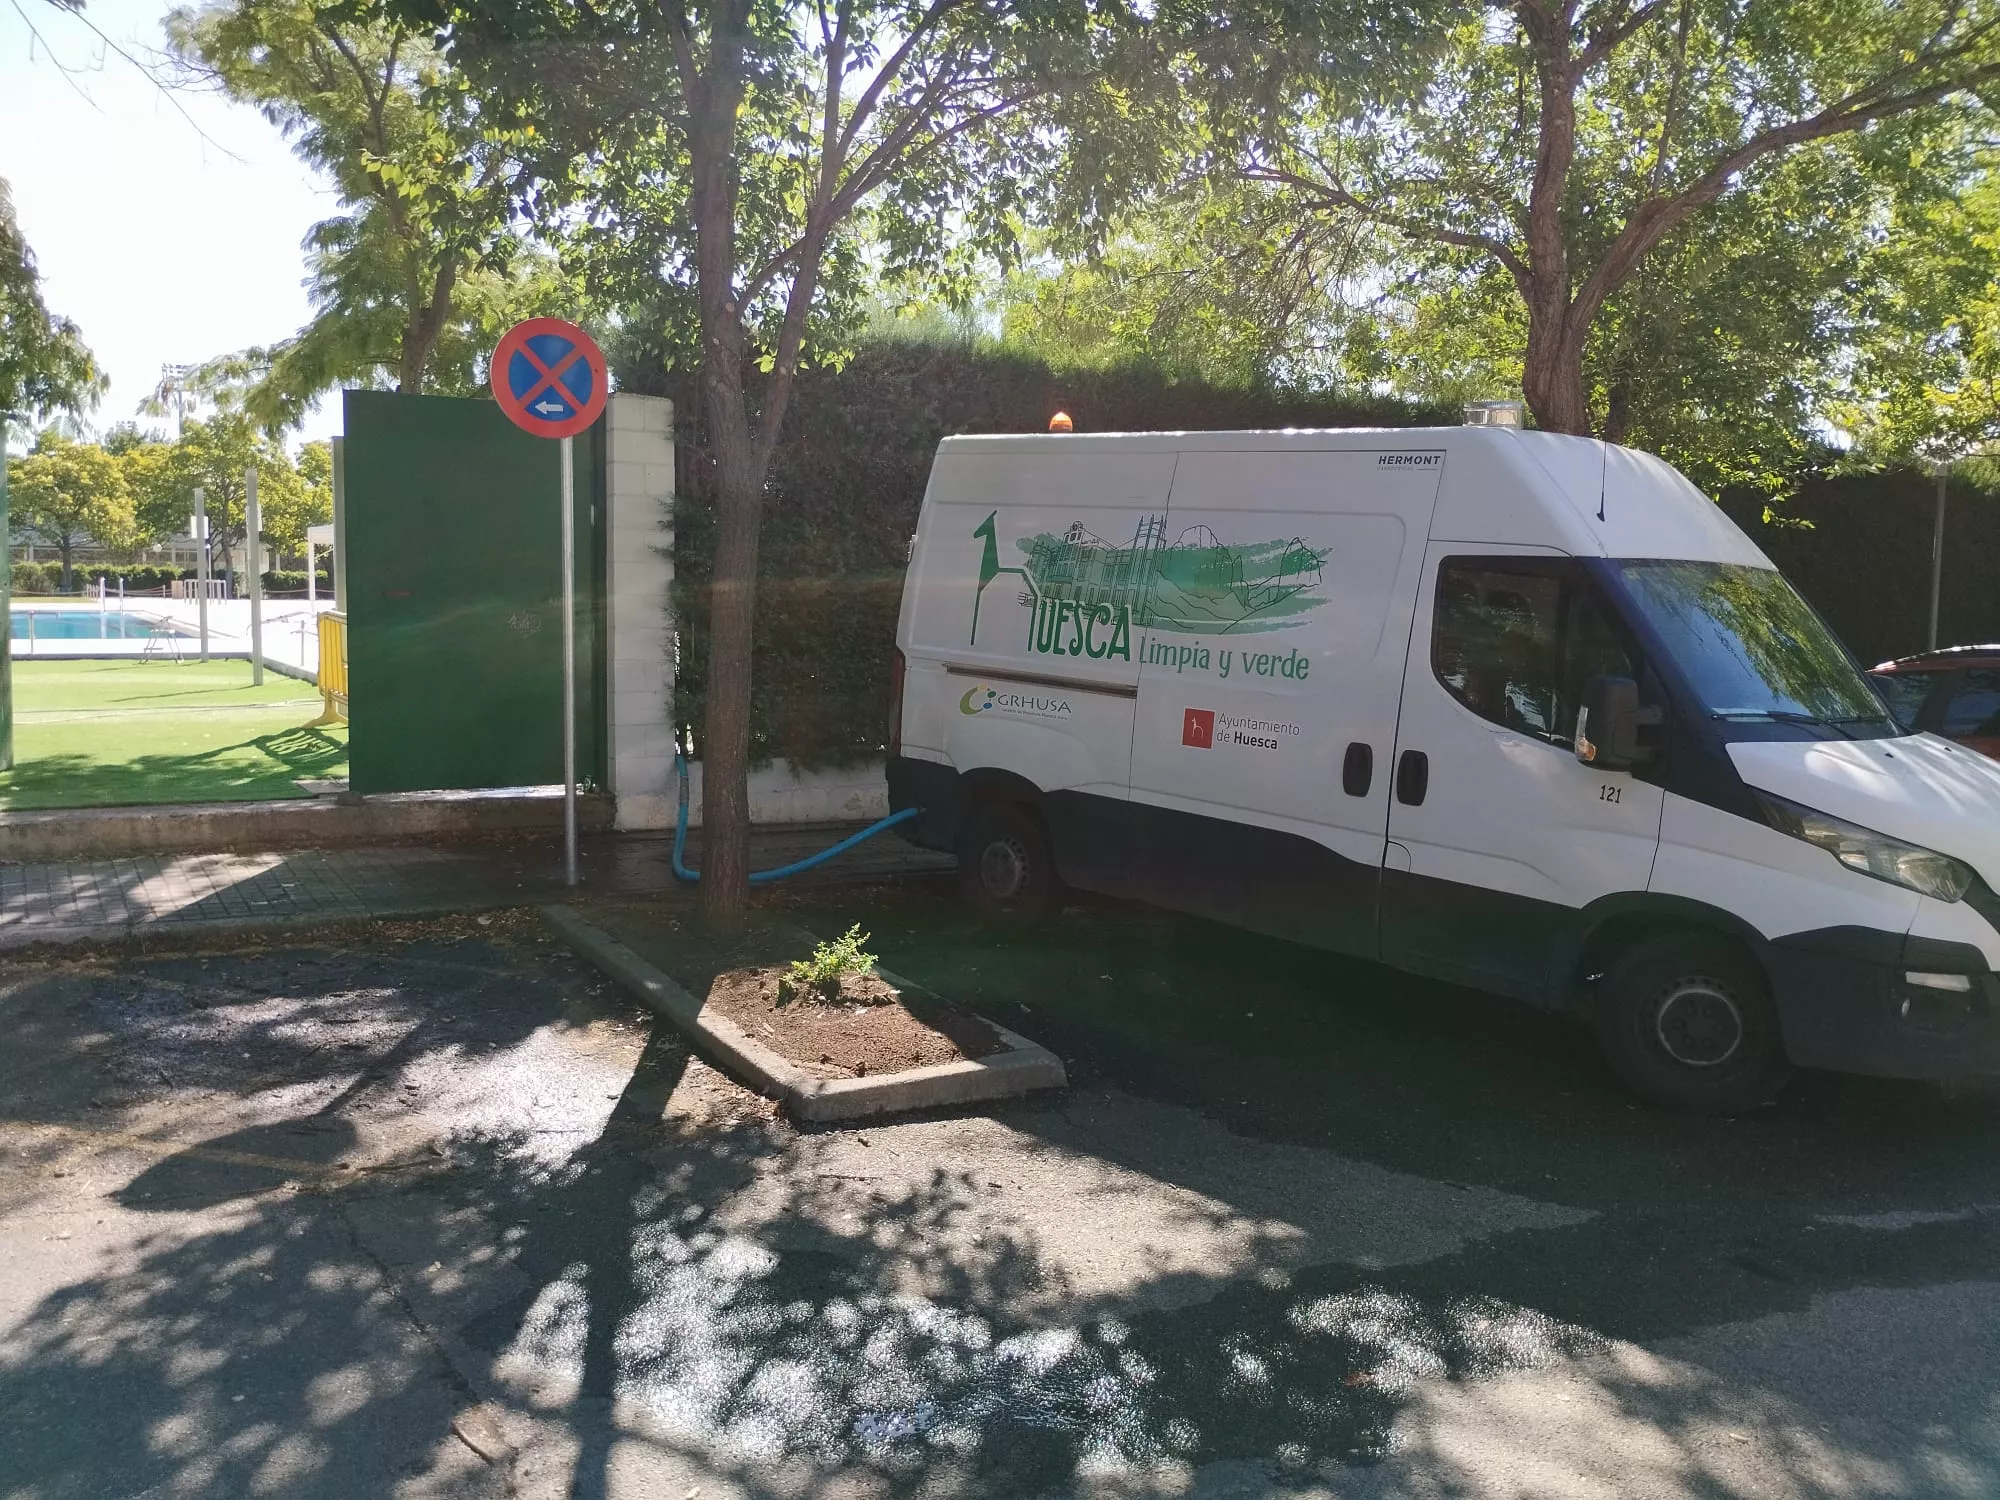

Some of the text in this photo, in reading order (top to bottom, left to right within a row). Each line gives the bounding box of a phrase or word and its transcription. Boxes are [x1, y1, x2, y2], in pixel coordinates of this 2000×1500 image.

[1378, 455, 1441, 465] HERMONT
[1139, 636, 1210, 673] Limpia
[1219, 650, 1233, 679] y
[1242, 649, 1309, 680] verde
[997, 694, 1072, 714] GRHUSA
[1218, 713, 1300, 736] Ayuntamiento
[1216, 730, 1278, 750] de Huesca
[1599, 785, 1622, 804] 121
